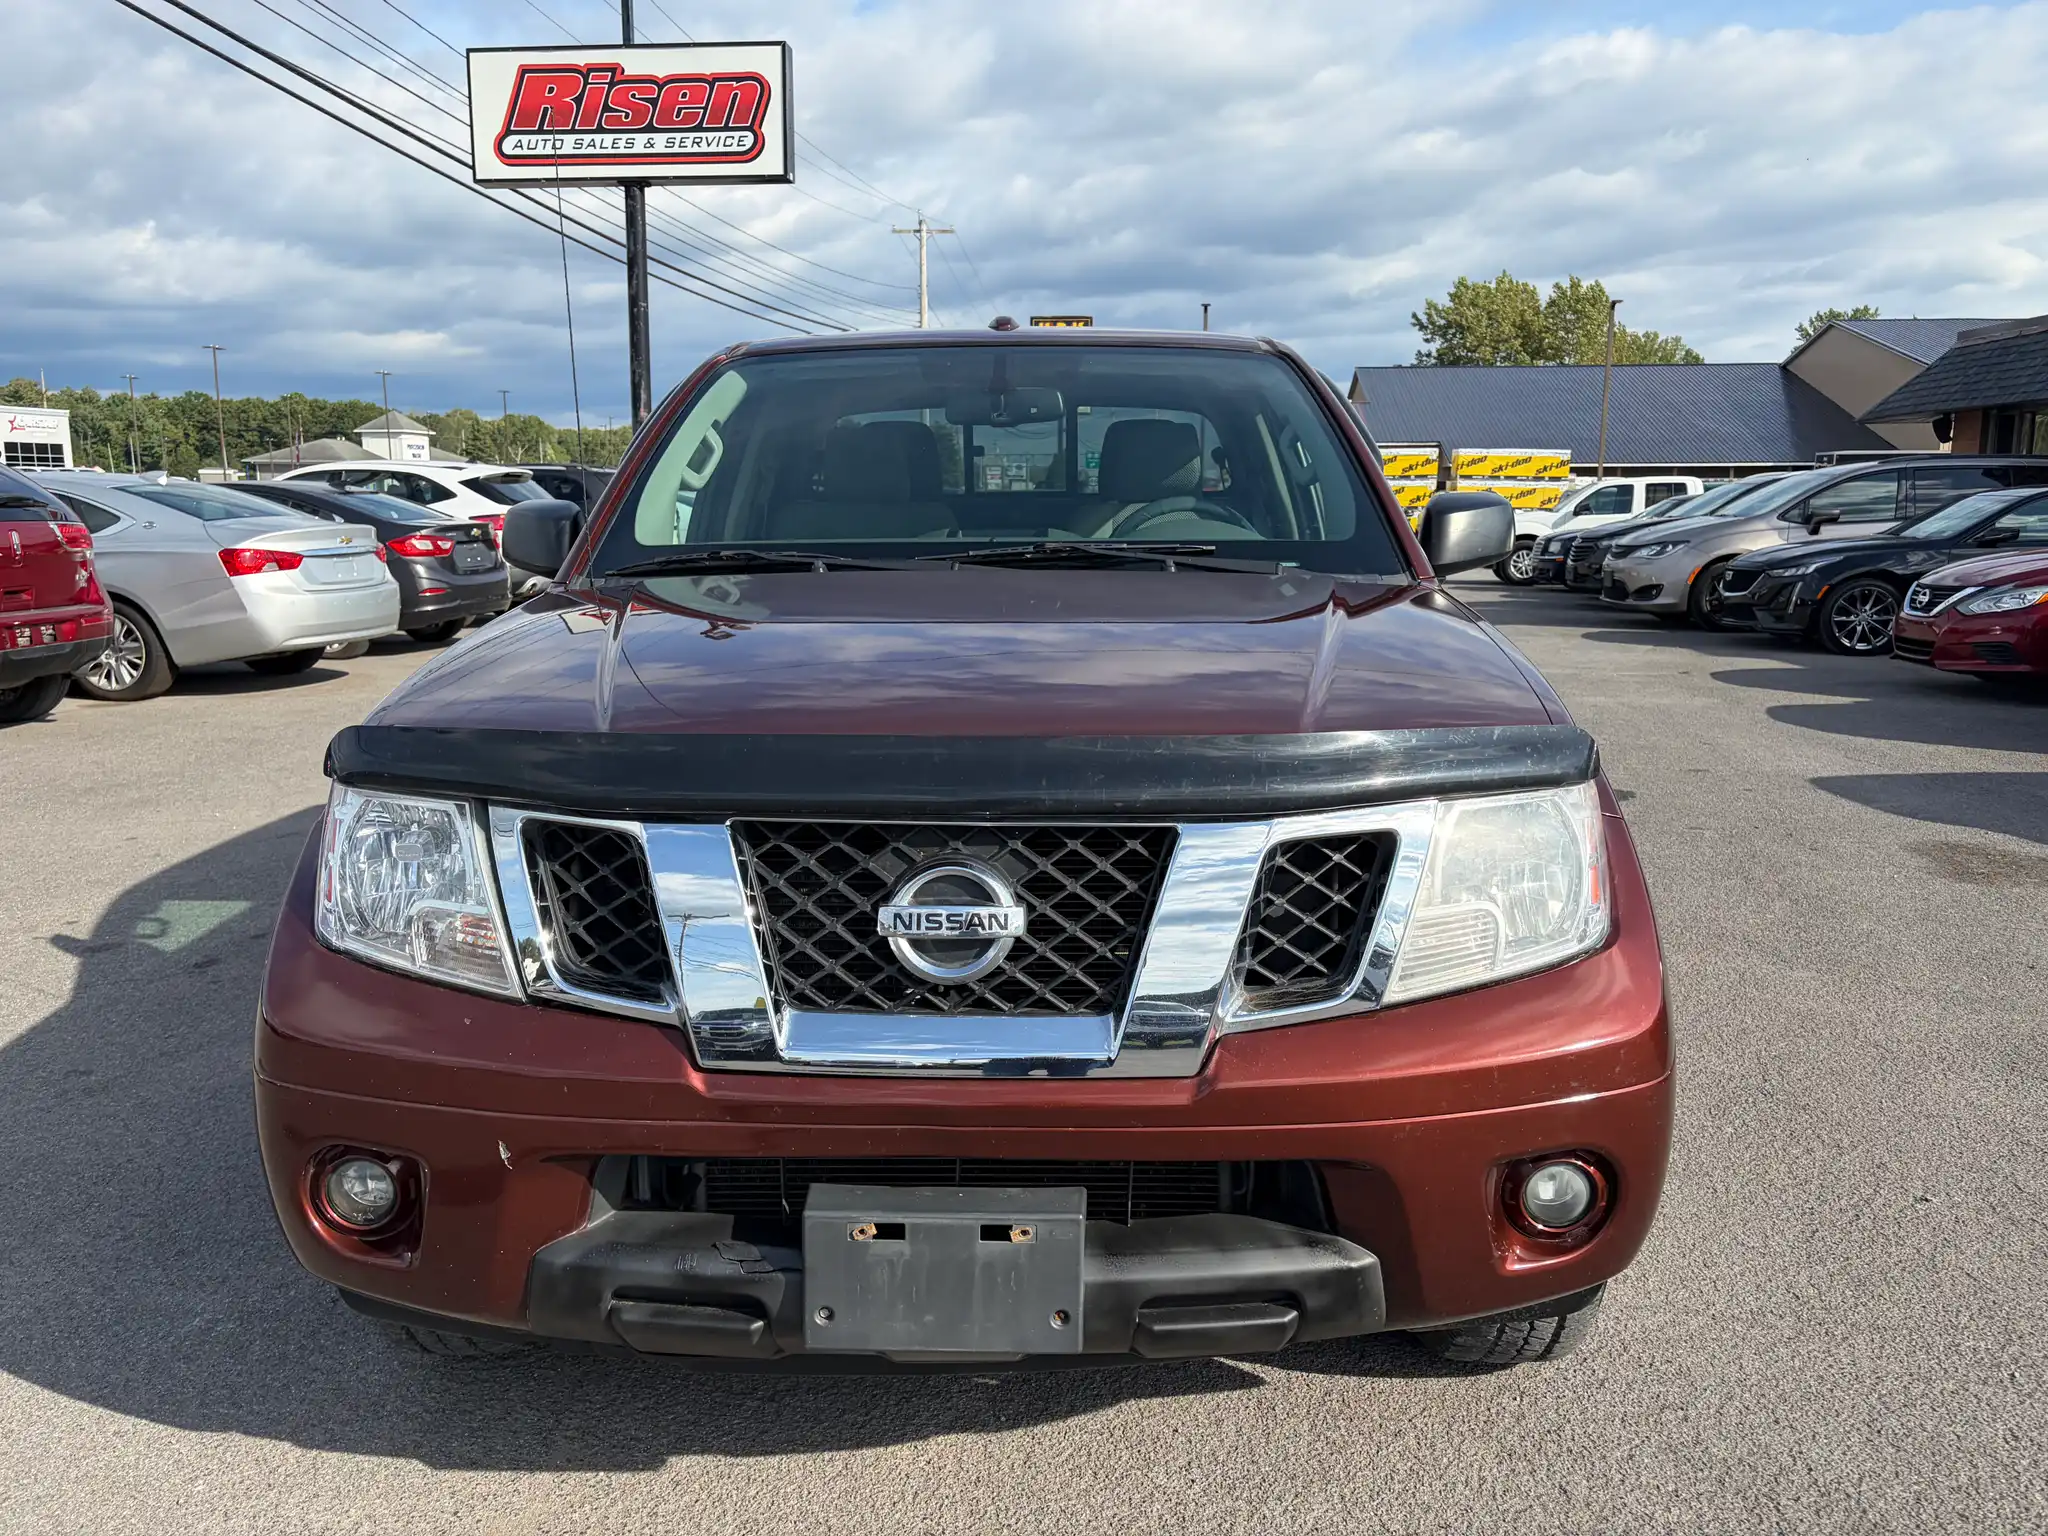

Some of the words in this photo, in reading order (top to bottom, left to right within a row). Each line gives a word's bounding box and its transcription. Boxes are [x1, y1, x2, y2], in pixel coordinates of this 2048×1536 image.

[511, 71, 761, 131] Risen
[512, 137, 564, 151] AUTO
[572, 136, 635, 150] SALES
[643, 136, 656, 149] &
[664, 134, 749, 149] SERVICE
[1491, 456, 1532, 475] ski-doo
[893, 912, 1009, 932] NISSAN
